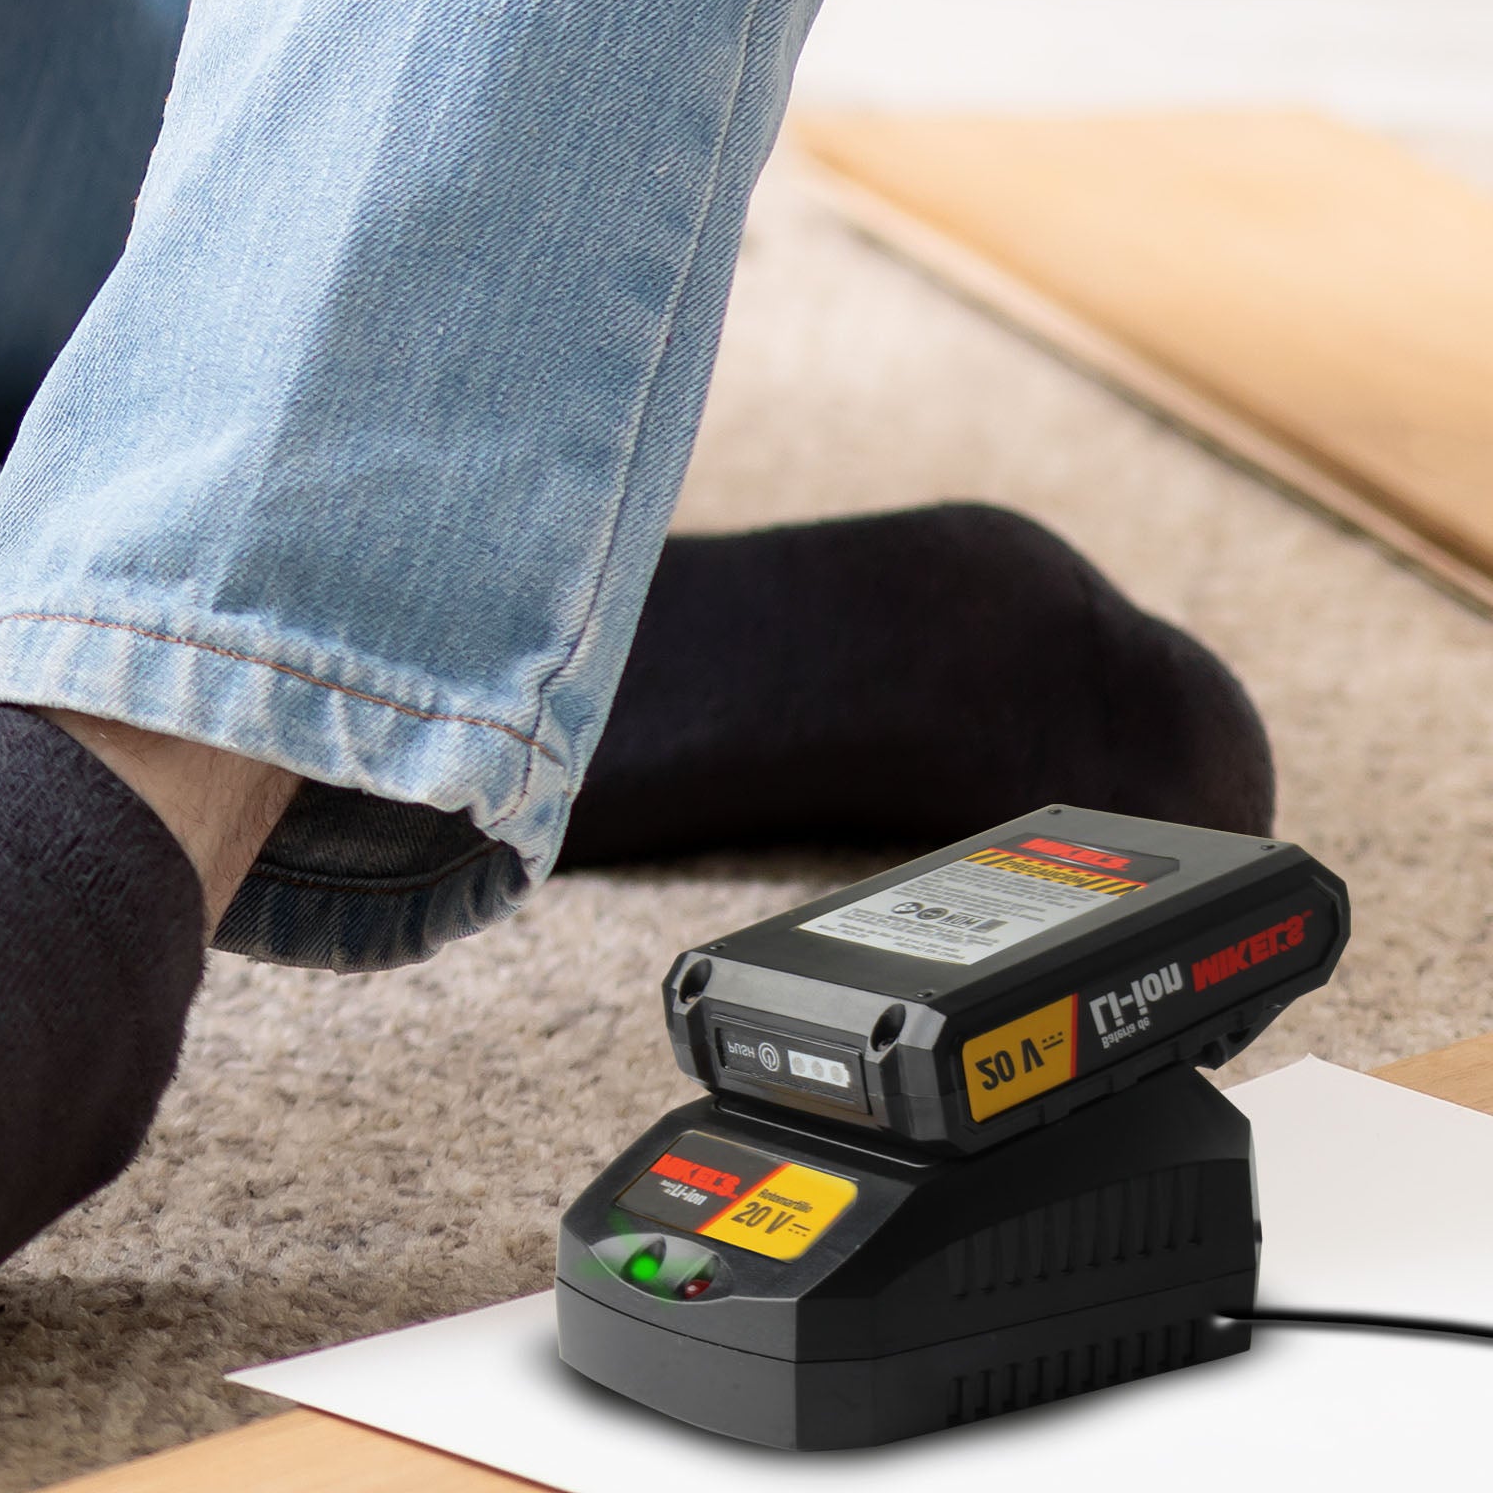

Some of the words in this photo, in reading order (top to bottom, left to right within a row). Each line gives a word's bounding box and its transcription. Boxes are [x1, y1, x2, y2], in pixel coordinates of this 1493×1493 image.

[669, 1184, 708, 1205] Li-ion
[731, 1201, 772, 1227] 20
[764, 1210, 796, 1234] V
